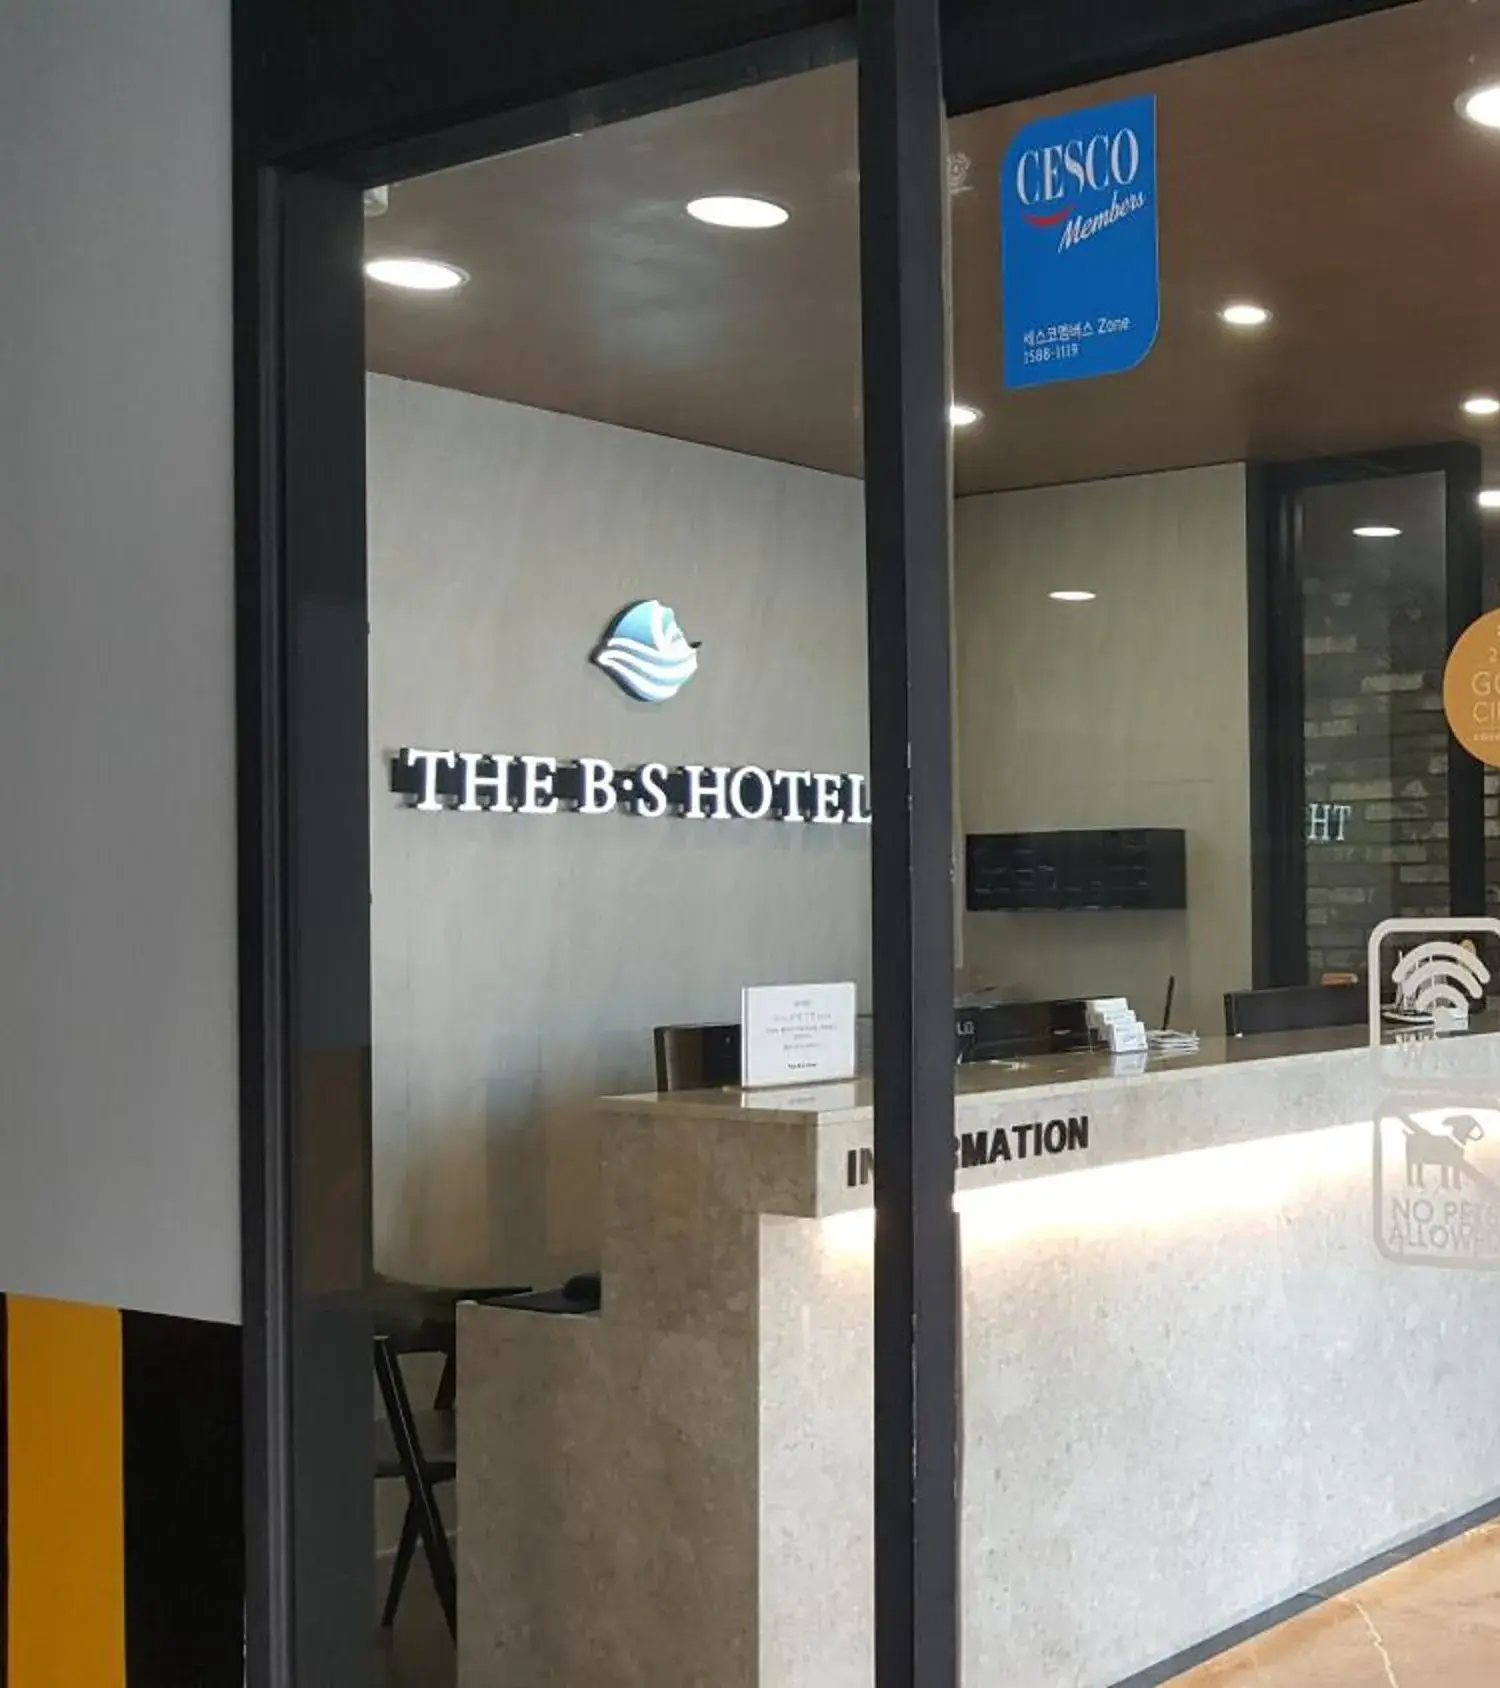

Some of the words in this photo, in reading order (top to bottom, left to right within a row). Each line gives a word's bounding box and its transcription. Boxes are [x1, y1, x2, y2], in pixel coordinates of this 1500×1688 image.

[1016, 128, 1139, 205] CESCO
[1058, 190, 1145, 253] Members
[1097, 316, 1131, 335] Zone
[407, 748, 557, 813] THE
[686, 766, 871, 824] HOTEL
[1392, 1197, 1434, 1223] NO
